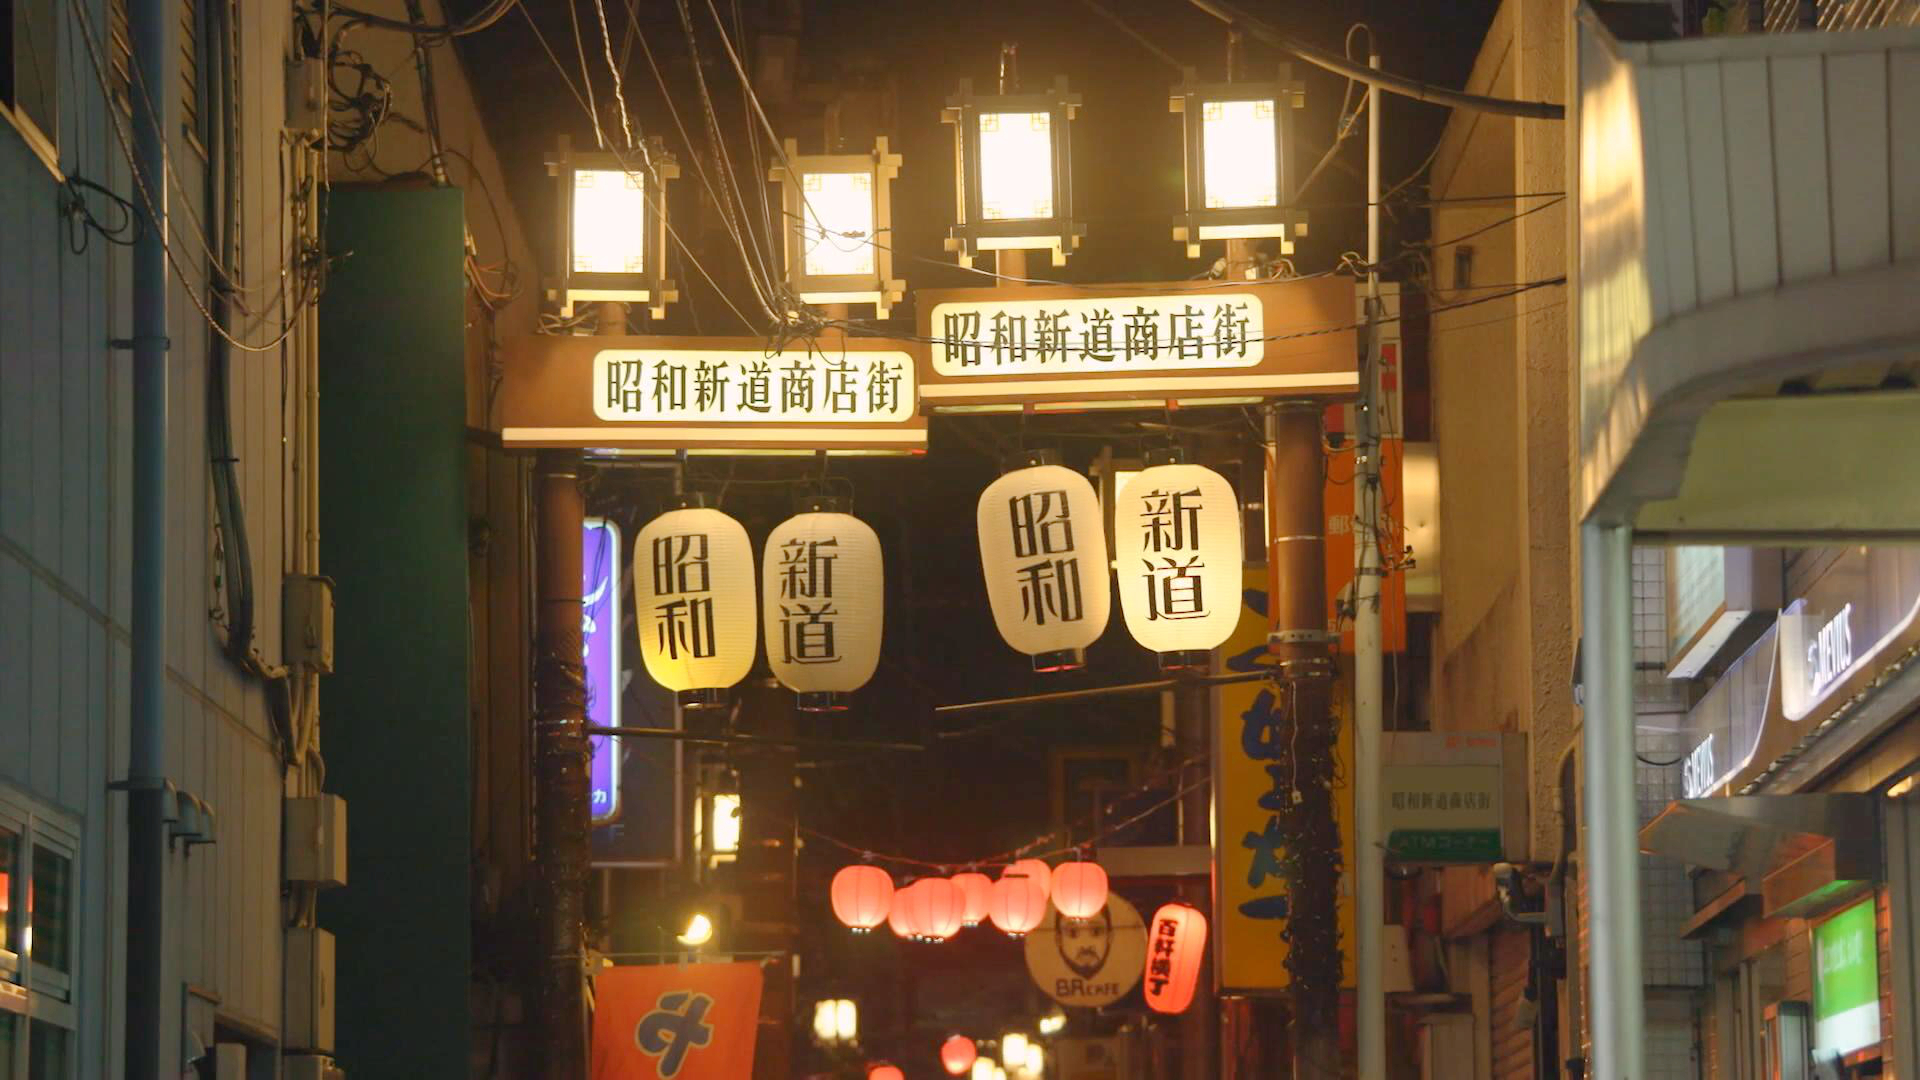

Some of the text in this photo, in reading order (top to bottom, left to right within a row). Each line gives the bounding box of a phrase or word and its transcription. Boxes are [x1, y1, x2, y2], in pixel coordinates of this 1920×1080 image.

[606, 359, 904, 415] 昭和新道商店街
[943, 302, 1249, 367] 昭和新道商店街
[651, 533, 717, 661] 昭和
[779, 535, 843, 665] 新道
[1009, 489, 1084, 626] 昭和
[1140, 485, 1212, 622] 新道
